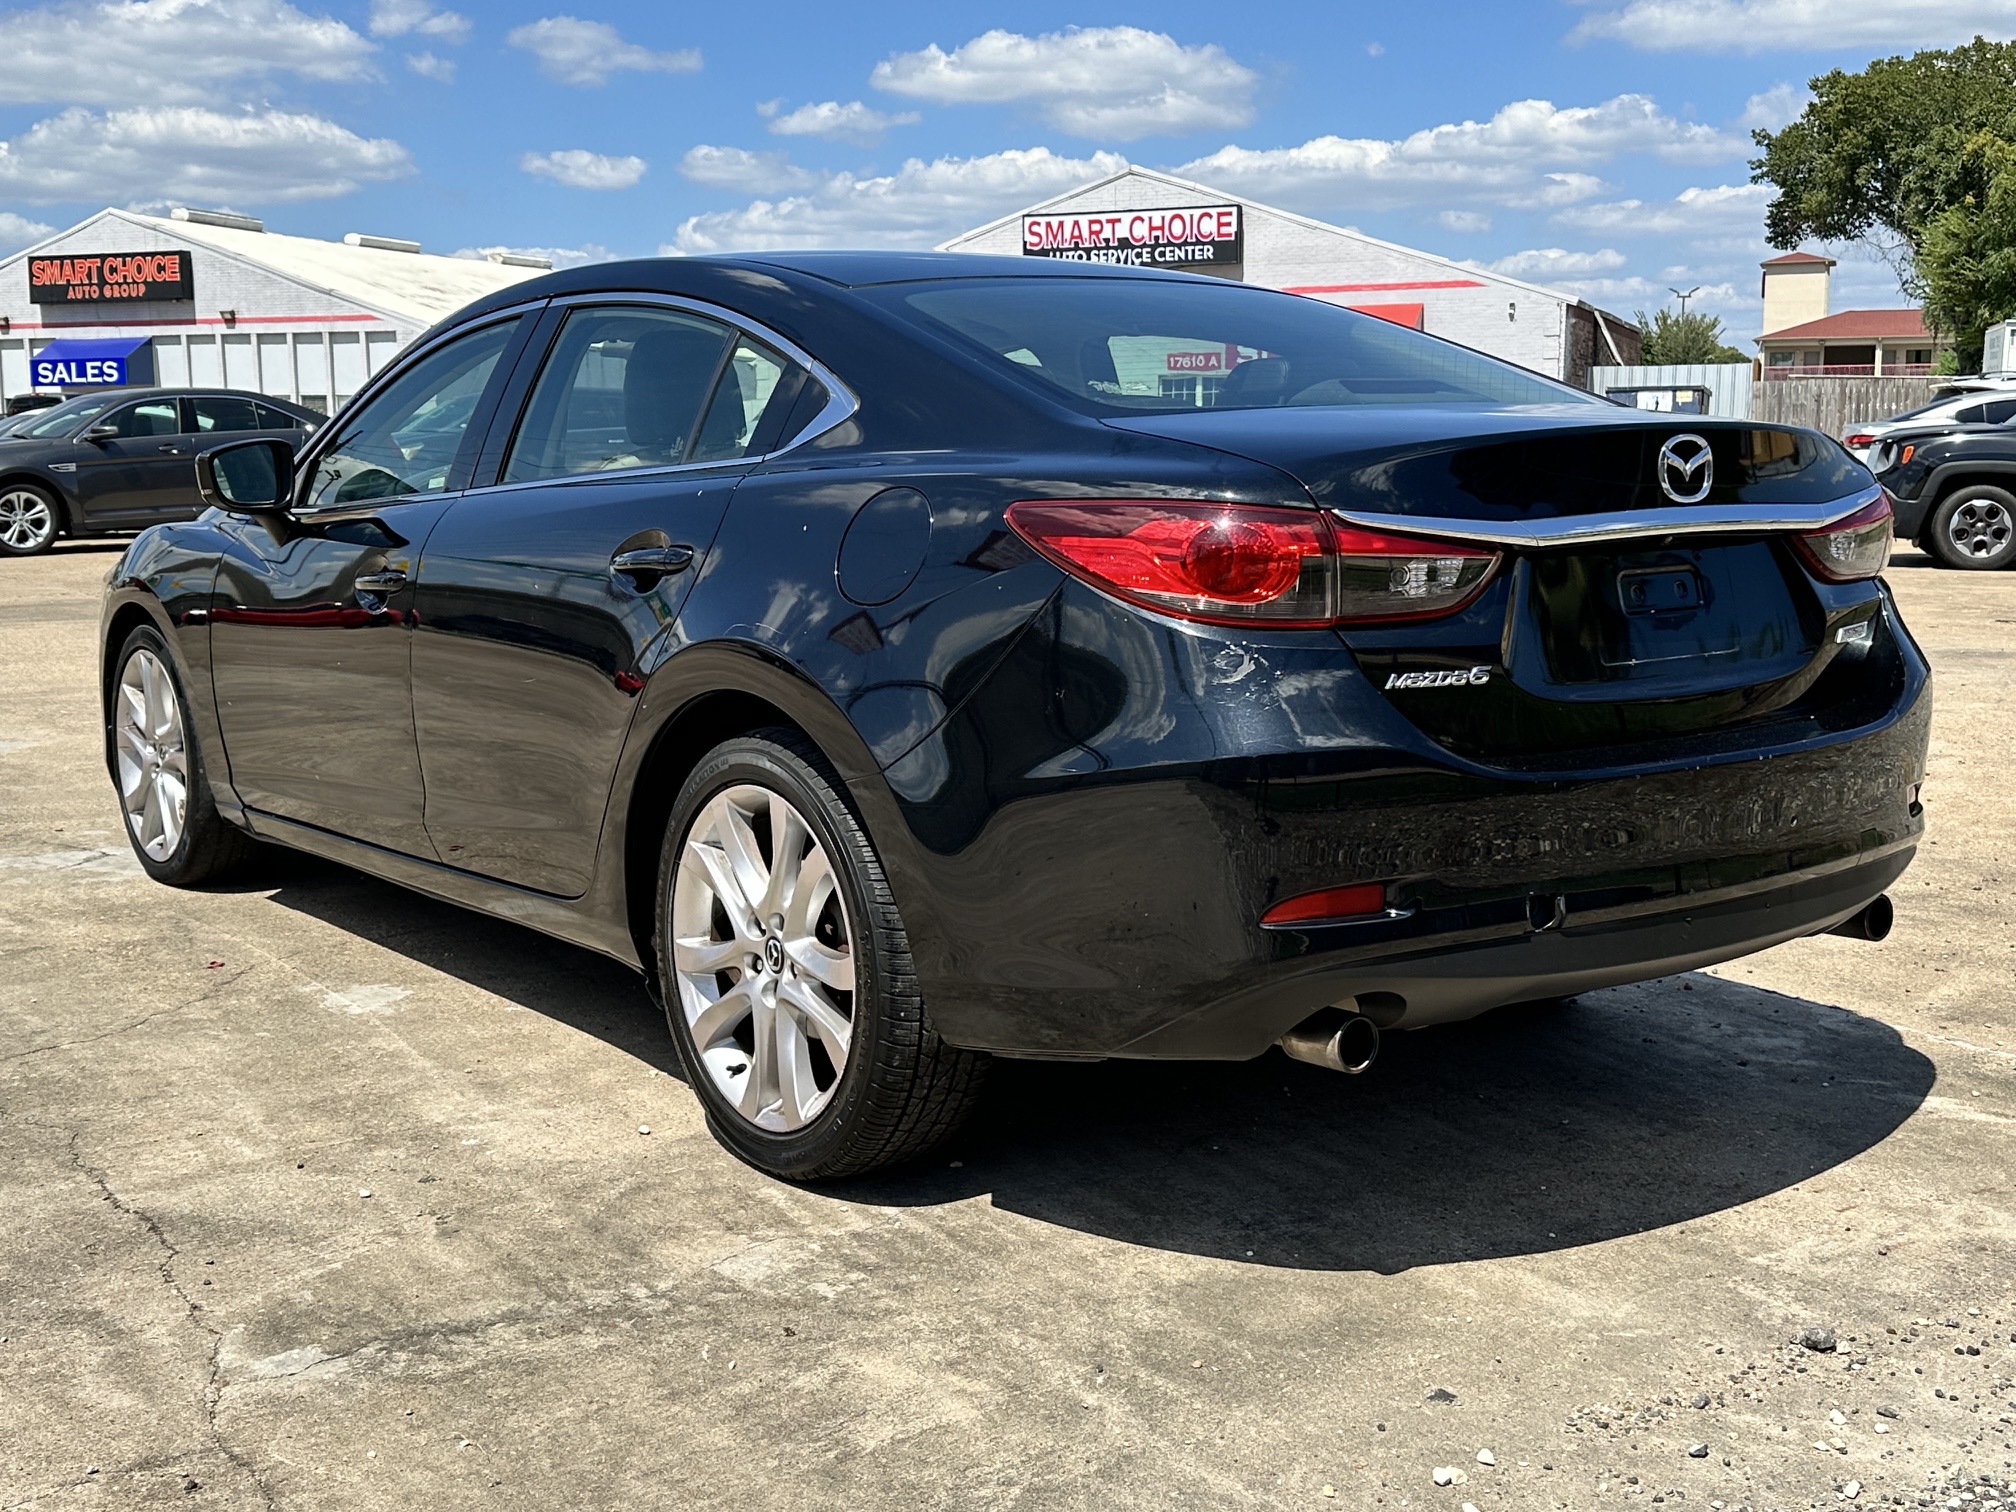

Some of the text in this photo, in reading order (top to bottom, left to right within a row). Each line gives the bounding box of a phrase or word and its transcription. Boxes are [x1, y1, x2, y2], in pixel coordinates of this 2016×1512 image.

[1027, 211, 1235, 249] SMART CHOICE
[1090, 248, 1152, 265] SERVICE
[1154, 245, 1214, 262] CENTER
[32, 255, 180, 286] SMART CHOICE
[67, 283, 146, 299] AUTO GROUP
[37, 361, 119, 383] SALES
[1169, 356, 1219, 369] 17610 A
